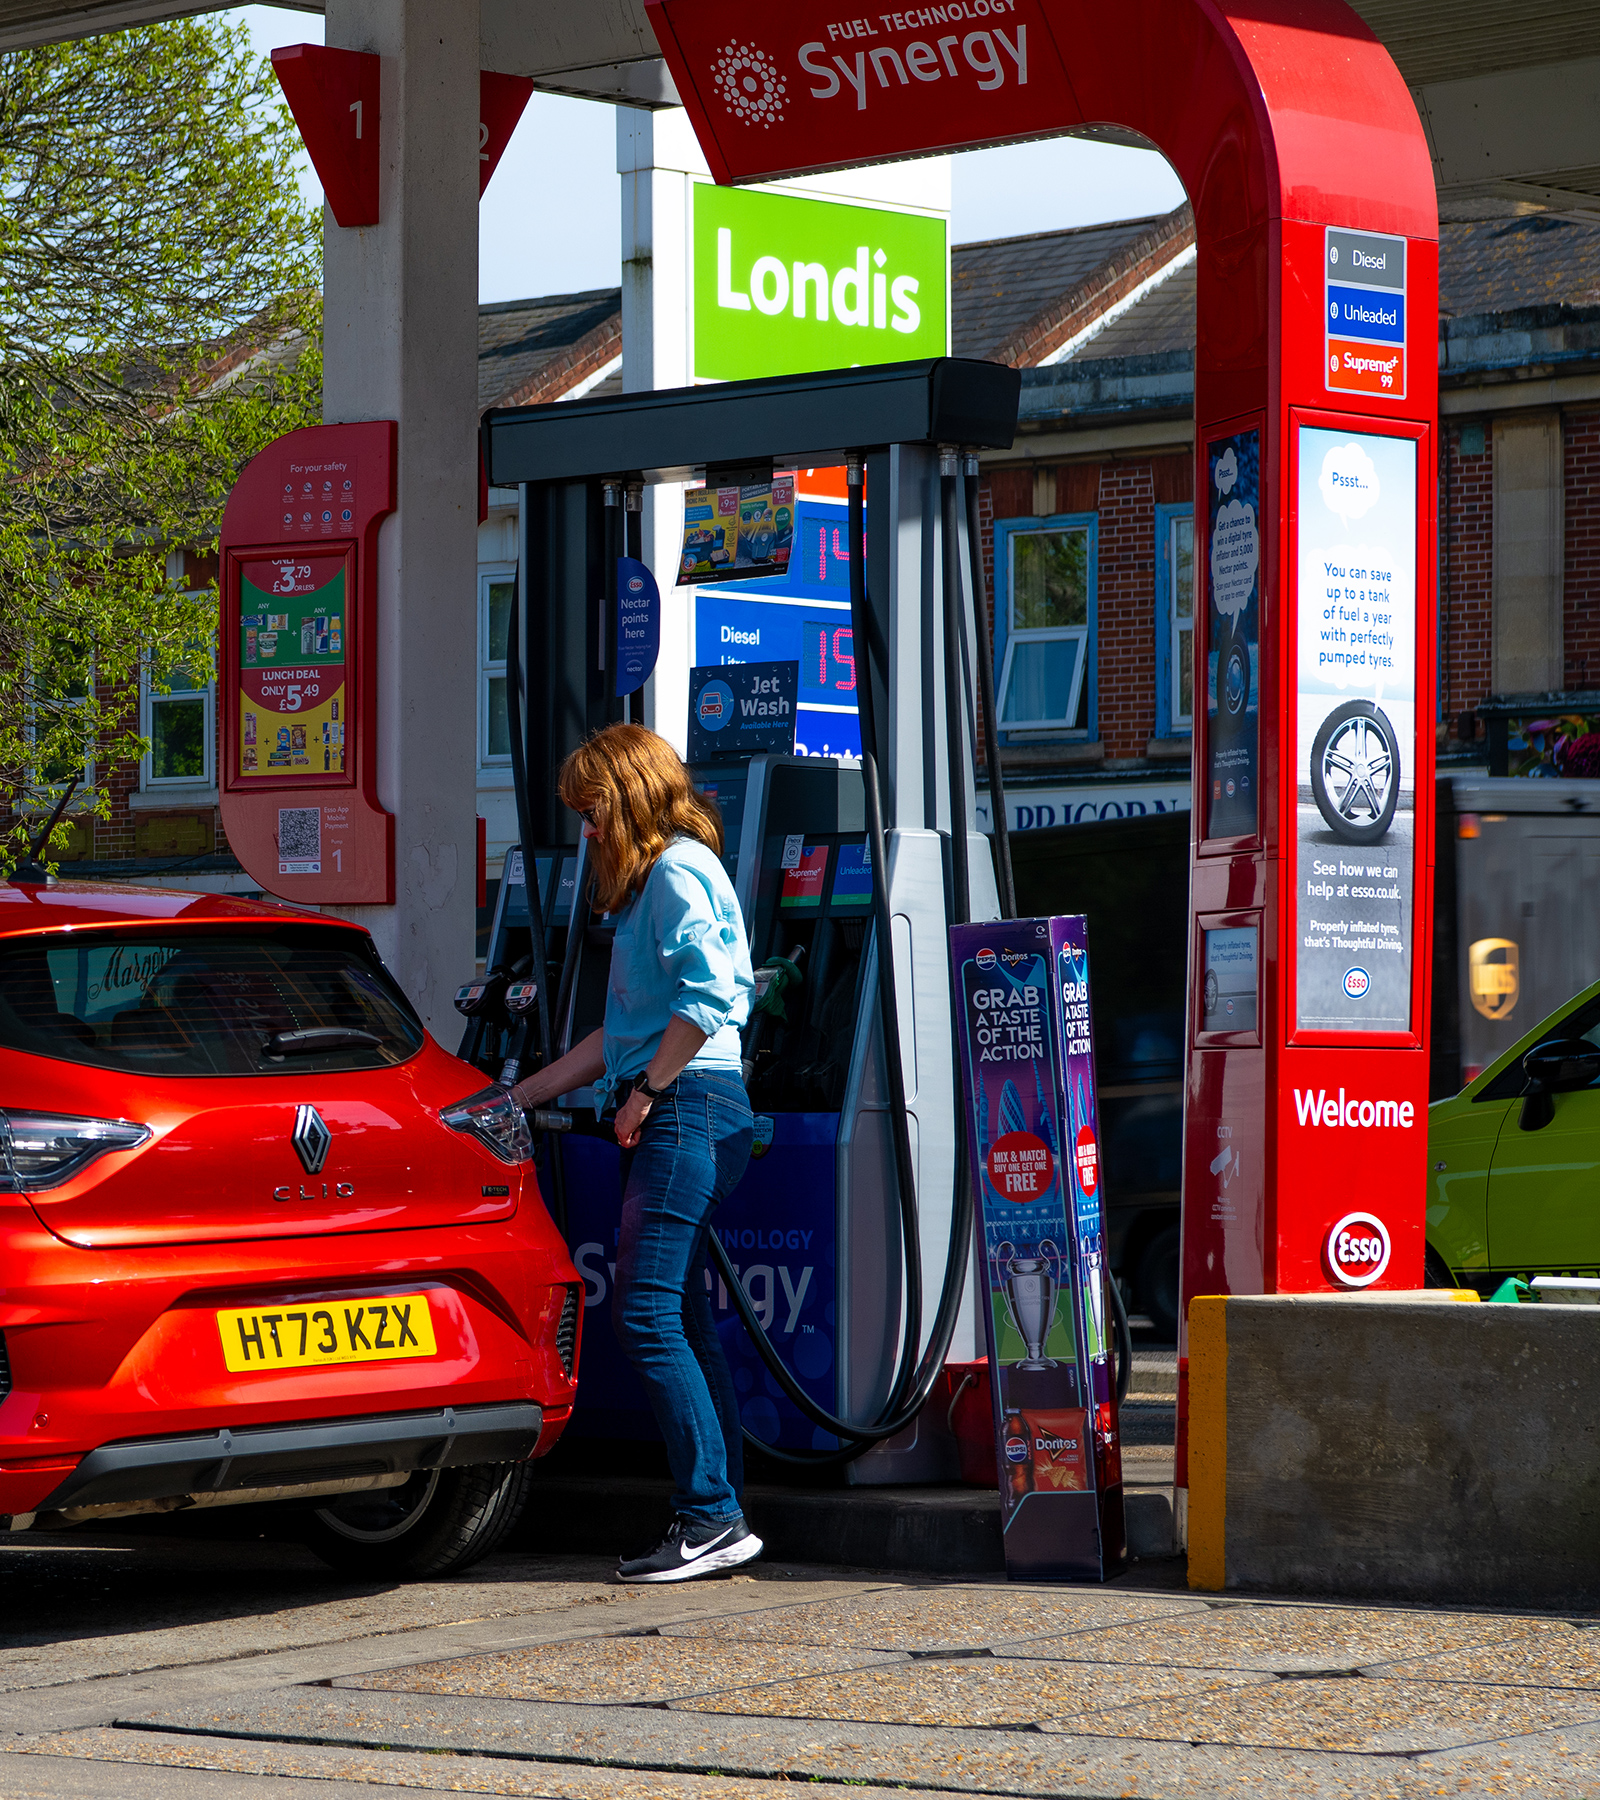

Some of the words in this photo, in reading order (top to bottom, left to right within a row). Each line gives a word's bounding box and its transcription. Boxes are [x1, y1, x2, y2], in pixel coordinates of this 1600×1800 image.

[827, 18, 878, 41] FUEL
[880, 0, 1017, 31] TECHNOLOGY
[798, 24, 1027, 110] Synergy
[349, 101, 362, 139] 1
[1352, 250, 1386, 270] Diesel
[717, 227, 920, 334] Londis
[1344, 304, 1397, 326] Unleaded
[1343, 352, 1398, 375] Supreme+
[1380, 375, 1393, 388] 99
[290, 465, 303, 473] For
[305, 464, 322, 474] your
[324, 462, 347, 473] safety
[1332, 471, 1368, 489] Pssst...
[1230, 516, 1244, 529] chance
[1324, 562, 1346, 578] You
[1349, 566, 1367, 580] can
[1370, 569, 1392, 582] save
[294, 584, 303, 592] OR
[302, 583, 315, 591] LESS
[1326, 587, 1341, 602] up
[1344, 586, 1356, 600] to
[1359, 589, 1365, 601] a
[1368, 588, 1390, 604] tank
[620, 598, 650, 609] Nectar
[622, 613, 649, 627] points
[1323, 605, 1336, 620] of
[1339, 606, 1360, 622] fuel
[1363, 611, 1369, 623] a
[1372, 612, 1392, 627] year
[625, 628, 645, 639] here
[720, 626, 760, 646] Diesel
[1320, 626, 1346, 642] with
[1350, 629, 1394, 651] perfectly
[1319, 650, 1366, 668] pumped
[1369, 654, 1394, 669] tyres.
[262, 670, 295, 681] LUNCH
[296, 669, 321, 680] DEAL
[261, 685, 286, 697] ONLY
[751, 676, 780, 694] Jet
[740, 697, 790, 717] Wash
[740, 721, 770, 731] Available
[771, 719, 789, 729] Here
[337, 806, 349, 815] App
[324, 823, 349, 831] Payment
[331, 849, 342, 872] 1
[1312, 860, 1337, 876] See
[1339, 861, 1364, 877] how
[1366, 866, 1381, 877] we
[1383, 866, 1398, 879] can
[840, 866, 872, 876] Unleaded
[1307, 881, 1334, 900] help
[1336, 884, 1349, 898] at
[1351, 883, 1402, 900] esso.co.uk.
[1310, 919, 1348, 936] Properly
[1350, 920, 1379, 935] inflated
[1381, 923, 1399, 936] tyres,
[1304, 935, 1330, 950] that's
[1332, 935, 1376, 953] Thoughtful
[1377, 937, 1403, 953] Driving.
[977, 955, 996, 963] PEPSI
[1001, 952, 1029, 962] Doritos
[1347, 976, 1367, 989] Esso
[972, 985, 1040, 1010] GRAB
[1063, 981, 1088, 1004] GRAB
[975, 1012, 989, 1028] A
[990, 1008, 1041, 1026] TASTE
[1065, 1006, 1071, 1020] A
[1071, 1004, 1089, 1019] TASTE
[976, 1026, 1002, 1045] OF
[1006, 1024, 1042, 1043] THE
[1066, 1022, 1076, 1038] OF
[1076, 1020, 1090, 1037] THE
[979, 1043, 1044, 1063] ACTION
[1068, 1037, 1092, 1056] ACTION
[1293, 1087, 1415, 1129] Welcome
[993, 1151, 1009, 1163] MIX
[1010, 1150, 1018, 1163] &
[1019, 1149, 1047, 1162] MATCH
[993, 1163, 1008, 1173] BUY
[1008, 1163, 1021, 1173] ONE
[1021, 1162, 1033, 1172] GET
[1034, 1161, 1047, 1171] ONE
[273, 1181, 355, 1201] CLIO
[1005, 1172, 1038, 1193] FREE
[1338, 1231, 1382, 1263] Esso
[237, 1309, 338, 1361] HT73
[344, 1303, 419, 1352] KZX
[1035, 1437, 1078, 1451] Doritos
